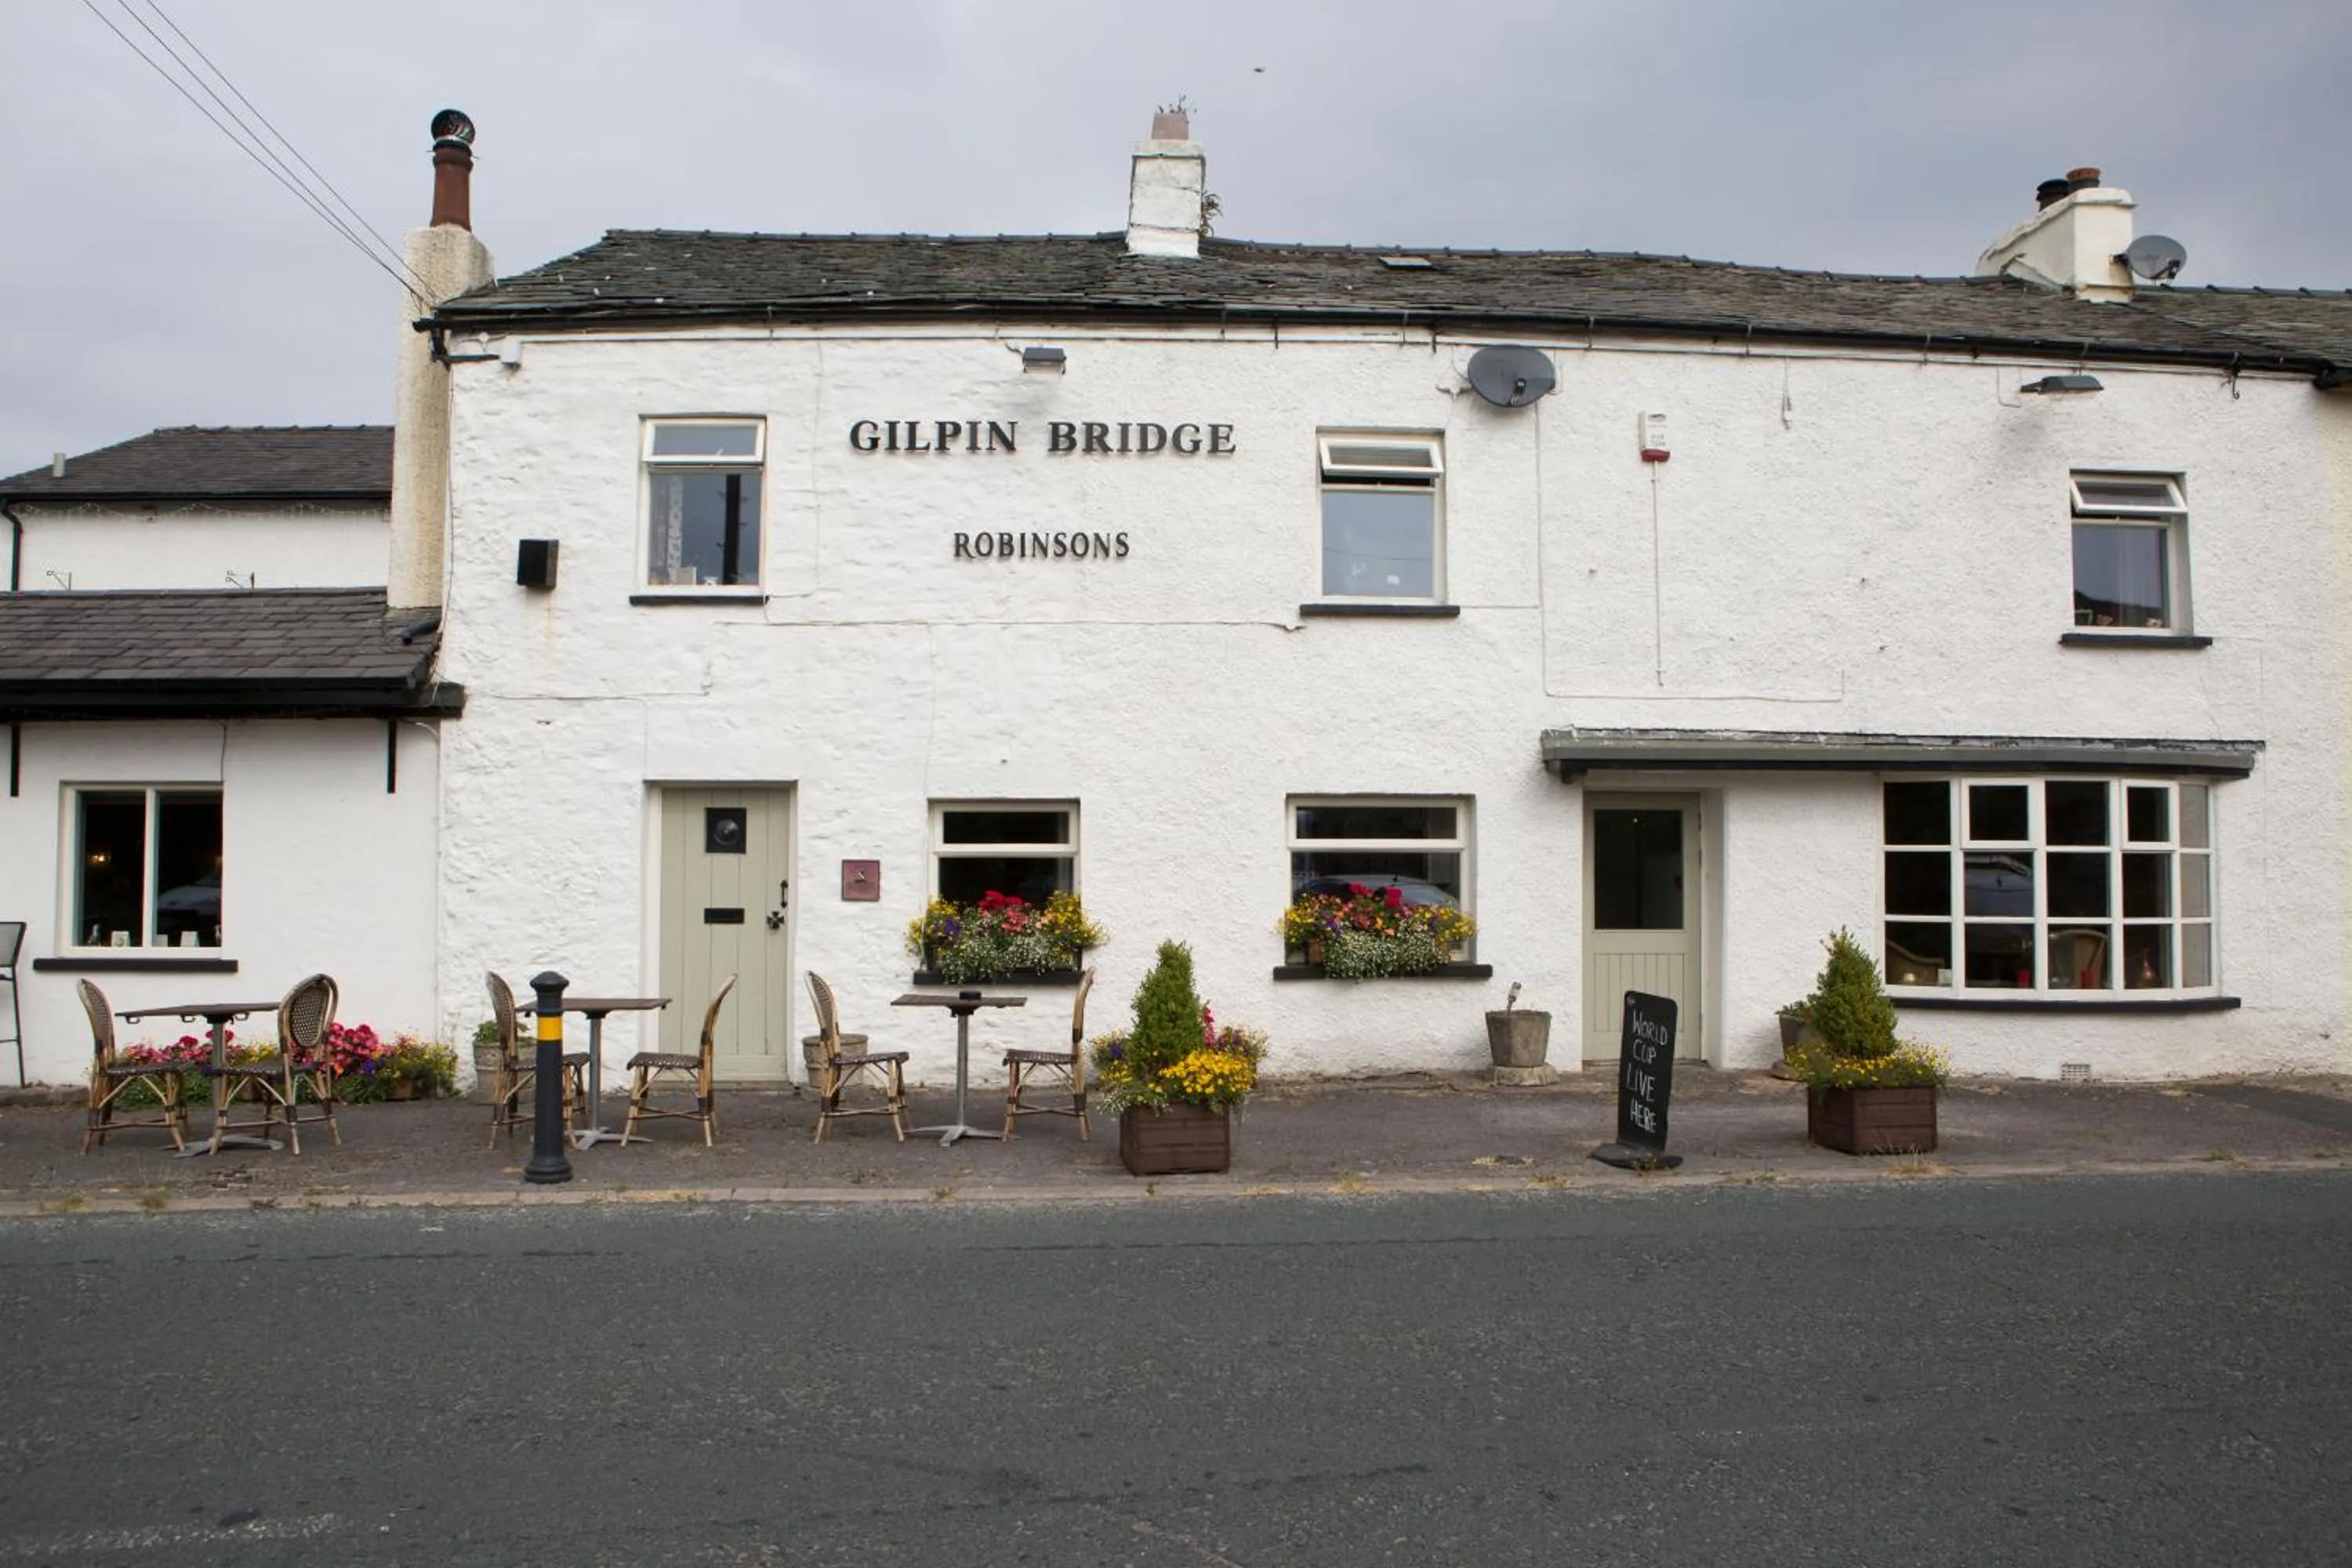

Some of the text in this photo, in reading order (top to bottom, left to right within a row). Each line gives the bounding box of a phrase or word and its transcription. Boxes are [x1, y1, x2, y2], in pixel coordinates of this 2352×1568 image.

[850, 420, 1236, 455] GILPIN BRIDGE
[953, 532, 1130, 560] ROBINSONS
[1632, 1009, 1668, 1046] WORLD
[1632, 1039, 1657, 1065] CUP
[1625, 1063, 1656, 1102] LIVE
[1629, 1100, 1657, 1134] HERE
